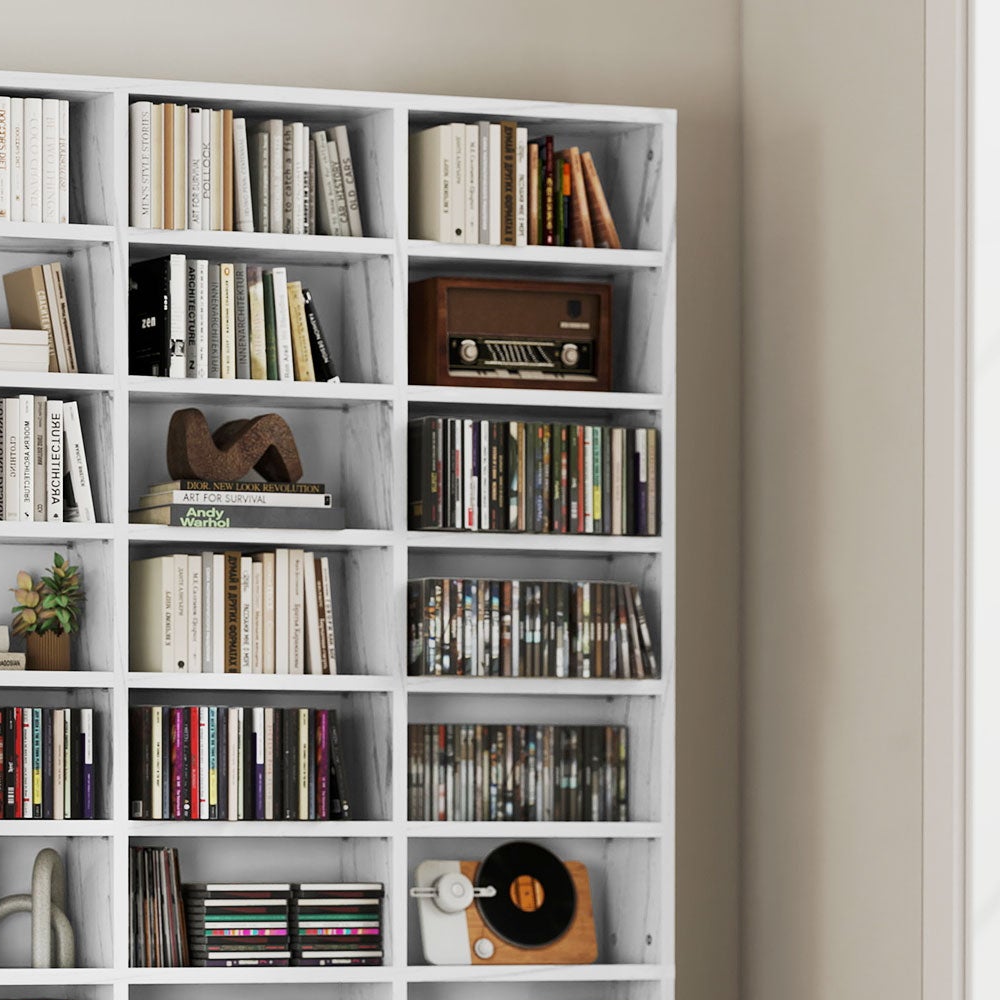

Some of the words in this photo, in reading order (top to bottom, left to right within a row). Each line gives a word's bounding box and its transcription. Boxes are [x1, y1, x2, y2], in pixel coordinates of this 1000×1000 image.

[141, 111, 149, 152] STORIES
[141, 154, 149, 184] STYLE
[192, 159, 200, 190] SURVIVAL
[202, 142, 210, 200] POLLOCK
[342, 157, 354, 184] CARS
[331, 160, 345, 200] HISTORY
[192, 193, 200, 208] FOR
[349, 190, 358, 210] OLD
[192, 210, 200, 224] ART
[338, 206, 348, 223] CAR
[188, 266, 196, 346] ARCHITECTURE
[141, 315, 156, 328] zen
[236, 271, 247, 365] INNENARCHITEKTUR
[213, 482, 233, 491] NEW
[235, 482, 260, 492] LOOK
[262, 483, 320, 493] REVOLUTION
[183, 493, 200, 503] ART
[203, 494, 222, 503] FOR
[225, 494, 266, 504] SURVIVAL
[180, 518, 230, 528] Warhol
[186, 507, 224, 520] Andy
